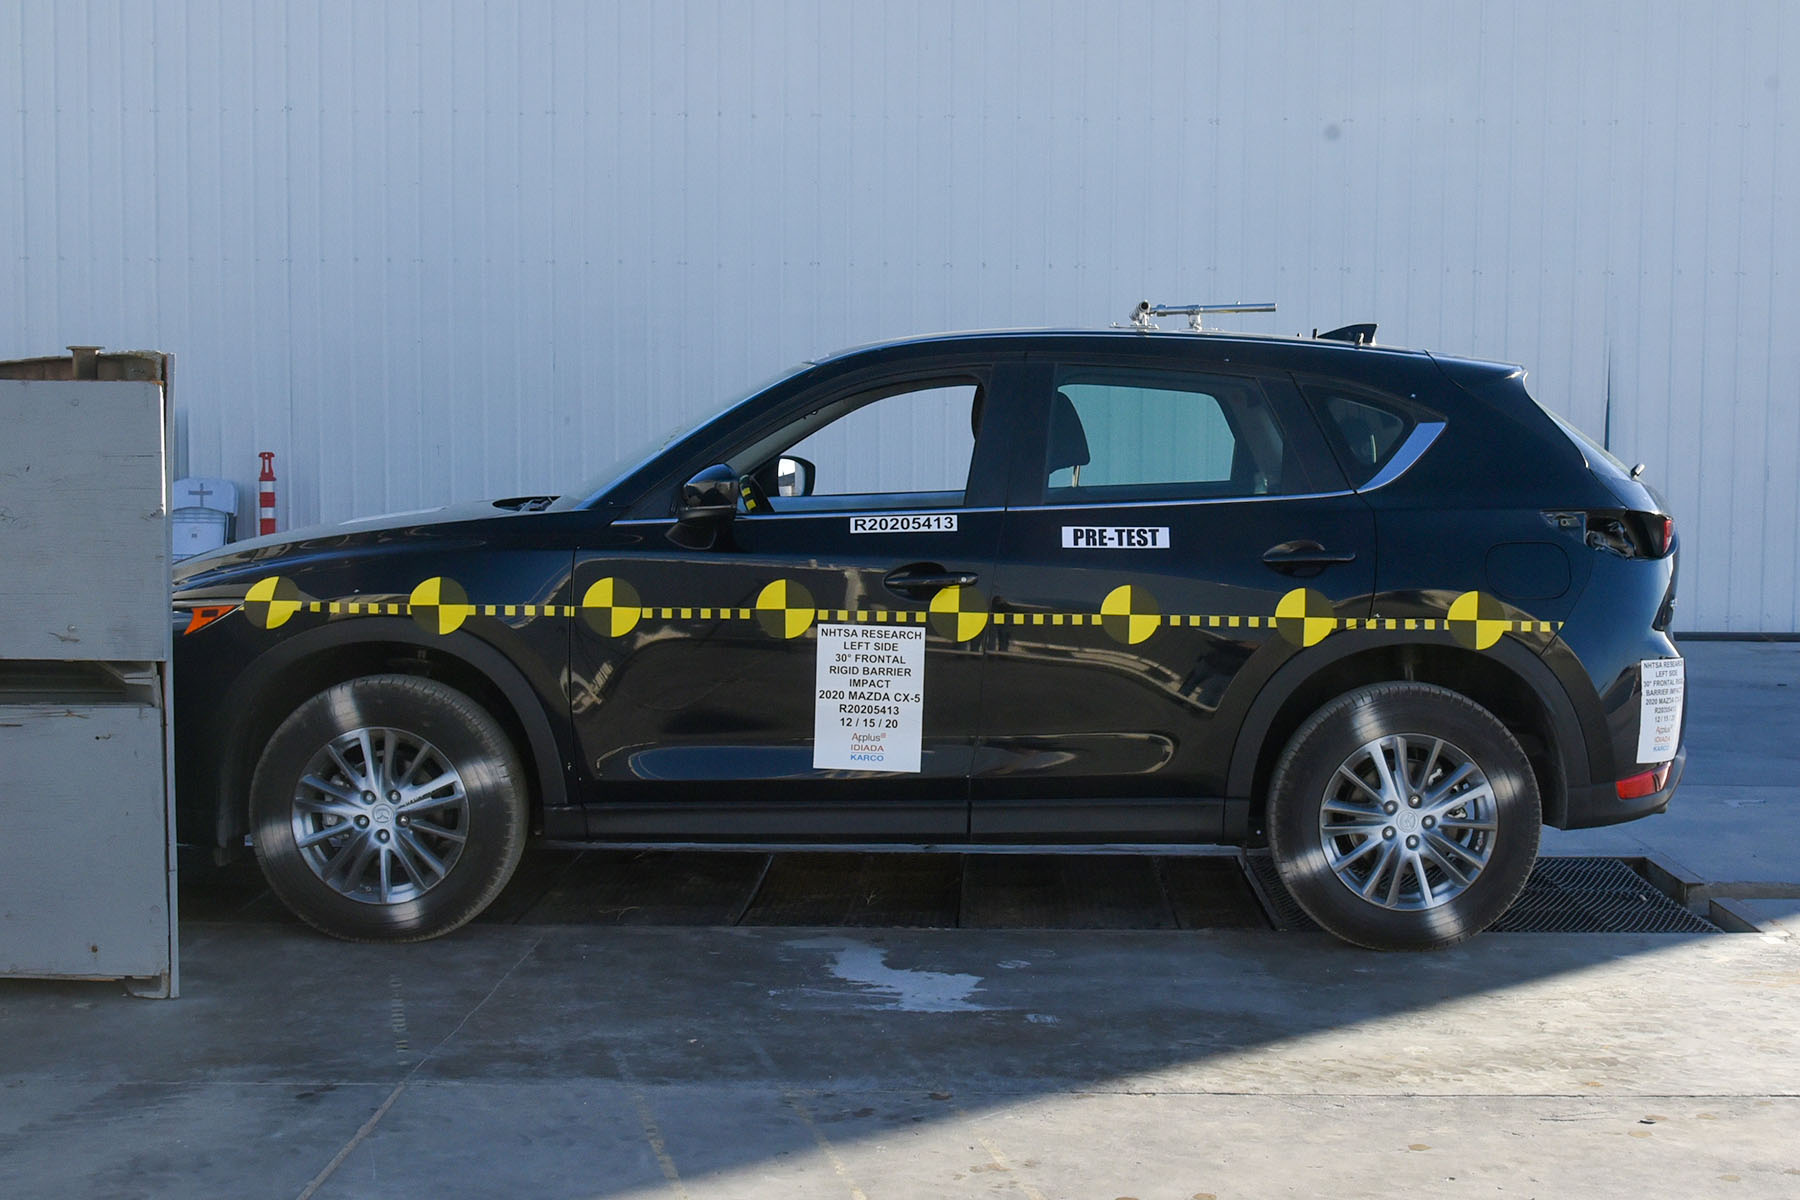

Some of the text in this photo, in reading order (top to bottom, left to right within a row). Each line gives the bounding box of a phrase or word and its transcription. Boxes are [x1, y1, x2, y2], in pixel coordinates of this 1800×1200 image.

[854, 516, 954, 531] R20205413
[1073, 528, 1159, 547] PRE-TEST
[821, 628, 922, 640] NHTSA RESEARCH
[843, 641, 899, 652] LEFT SIDE
[835, 653, 906, 664] 30° FRONTAL
[829, 665, 912, 677] RIGID BARRIER
[1655, 670, 1669, 678] LEFT
[849, 679, 891, 688] IMPACT
[1653, 679, 1675, 687] FRONTAL
[819, 690, 921, 703] 2020 MAZDA CX-5
[839, 704, 899, 715] R20205413
[840, 718, 853, 727] 12
[863, 718, 875, 728] 15
[885, 719, 898, 729] 20
[850, 744, 884, 752] IDIADA
